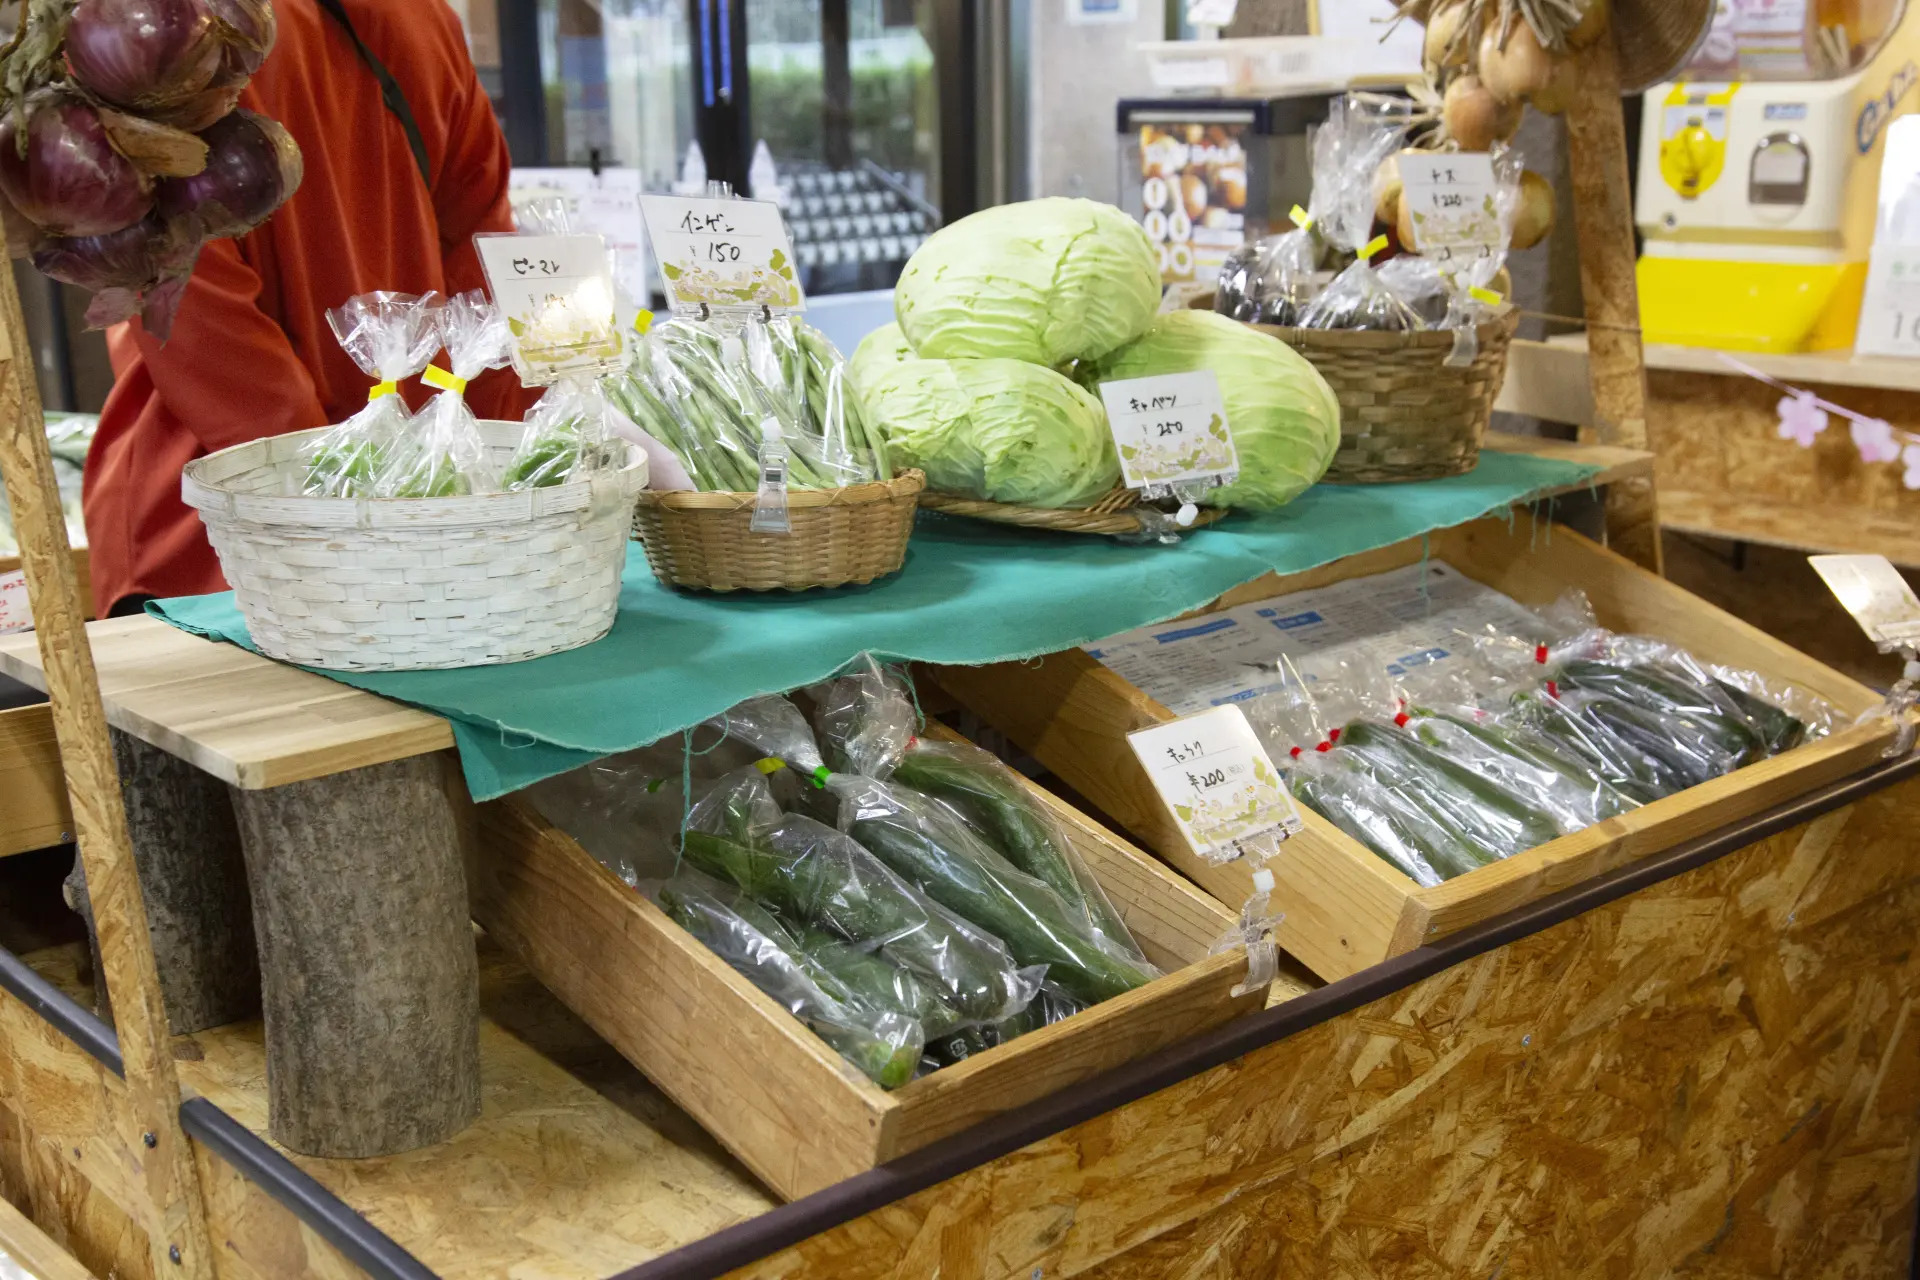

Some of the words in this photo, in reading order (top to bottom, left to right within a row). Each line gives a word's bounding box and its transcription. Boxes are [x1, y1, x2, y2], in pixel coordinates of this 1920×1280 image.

[681, 210, 735, 234] インゲン
[708, 242, 741, 263] 150
[1129, 394, 1177, 413] キャベツ
[1156, 421, 1183, 437] 250
